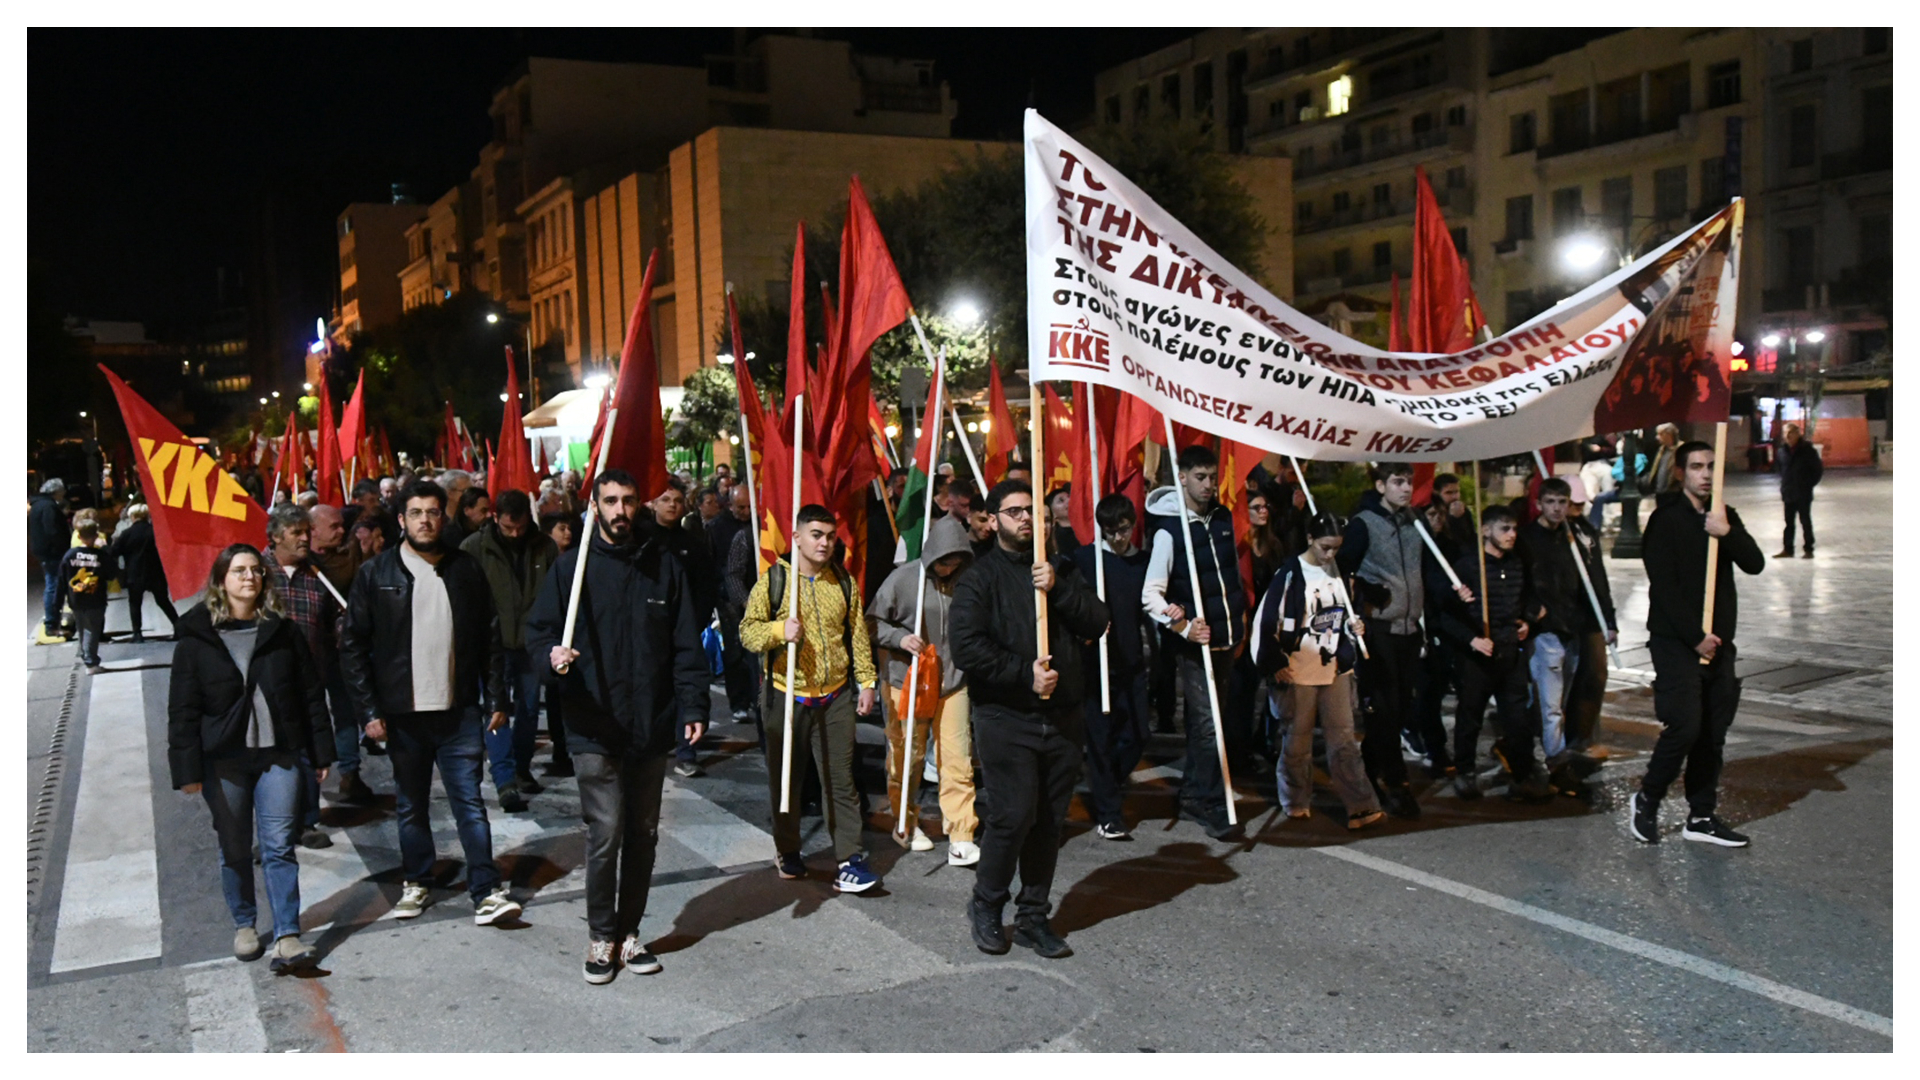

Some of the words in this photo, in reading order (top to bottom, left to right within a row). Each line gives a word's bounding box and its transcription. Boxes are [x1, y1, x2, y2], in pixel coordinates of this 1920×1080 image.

[1049, 330, 1110, 366] ΚΚΕ
[1053, 289, 1124, 332] στους
[1127, 320, 1251, 378] πολέμους
[1260, 363, 1314, 390] των
[1318, 375, 1377, 407] ΗΠΑ
[1418, 411, 1459, 425] ΤΟ
[1054, 257, 1119, 309] Στους
[1124, 297, 1232, 347] αγώνες
[1495, 382, 1542, 400] της
[1058, 216, 1123, 274] ΤΗΣ
[1345, 371, 1412, 391] ΤΟΥ
[1418, 318, 1639, 390] ΚΕΦΑΛΑΙΟΥ!
[1376, 322, 1566, 372] ΑΝΑΤΡΟΠΗ
[1122, 354, 1253, 425] ΟΡΓΑΝΩΣΕΙΣ
[1254, 410, 1359, 448] ΑΧΑΪΑΣ
[1364, 431, 1431, 454] ΚΝΕ
